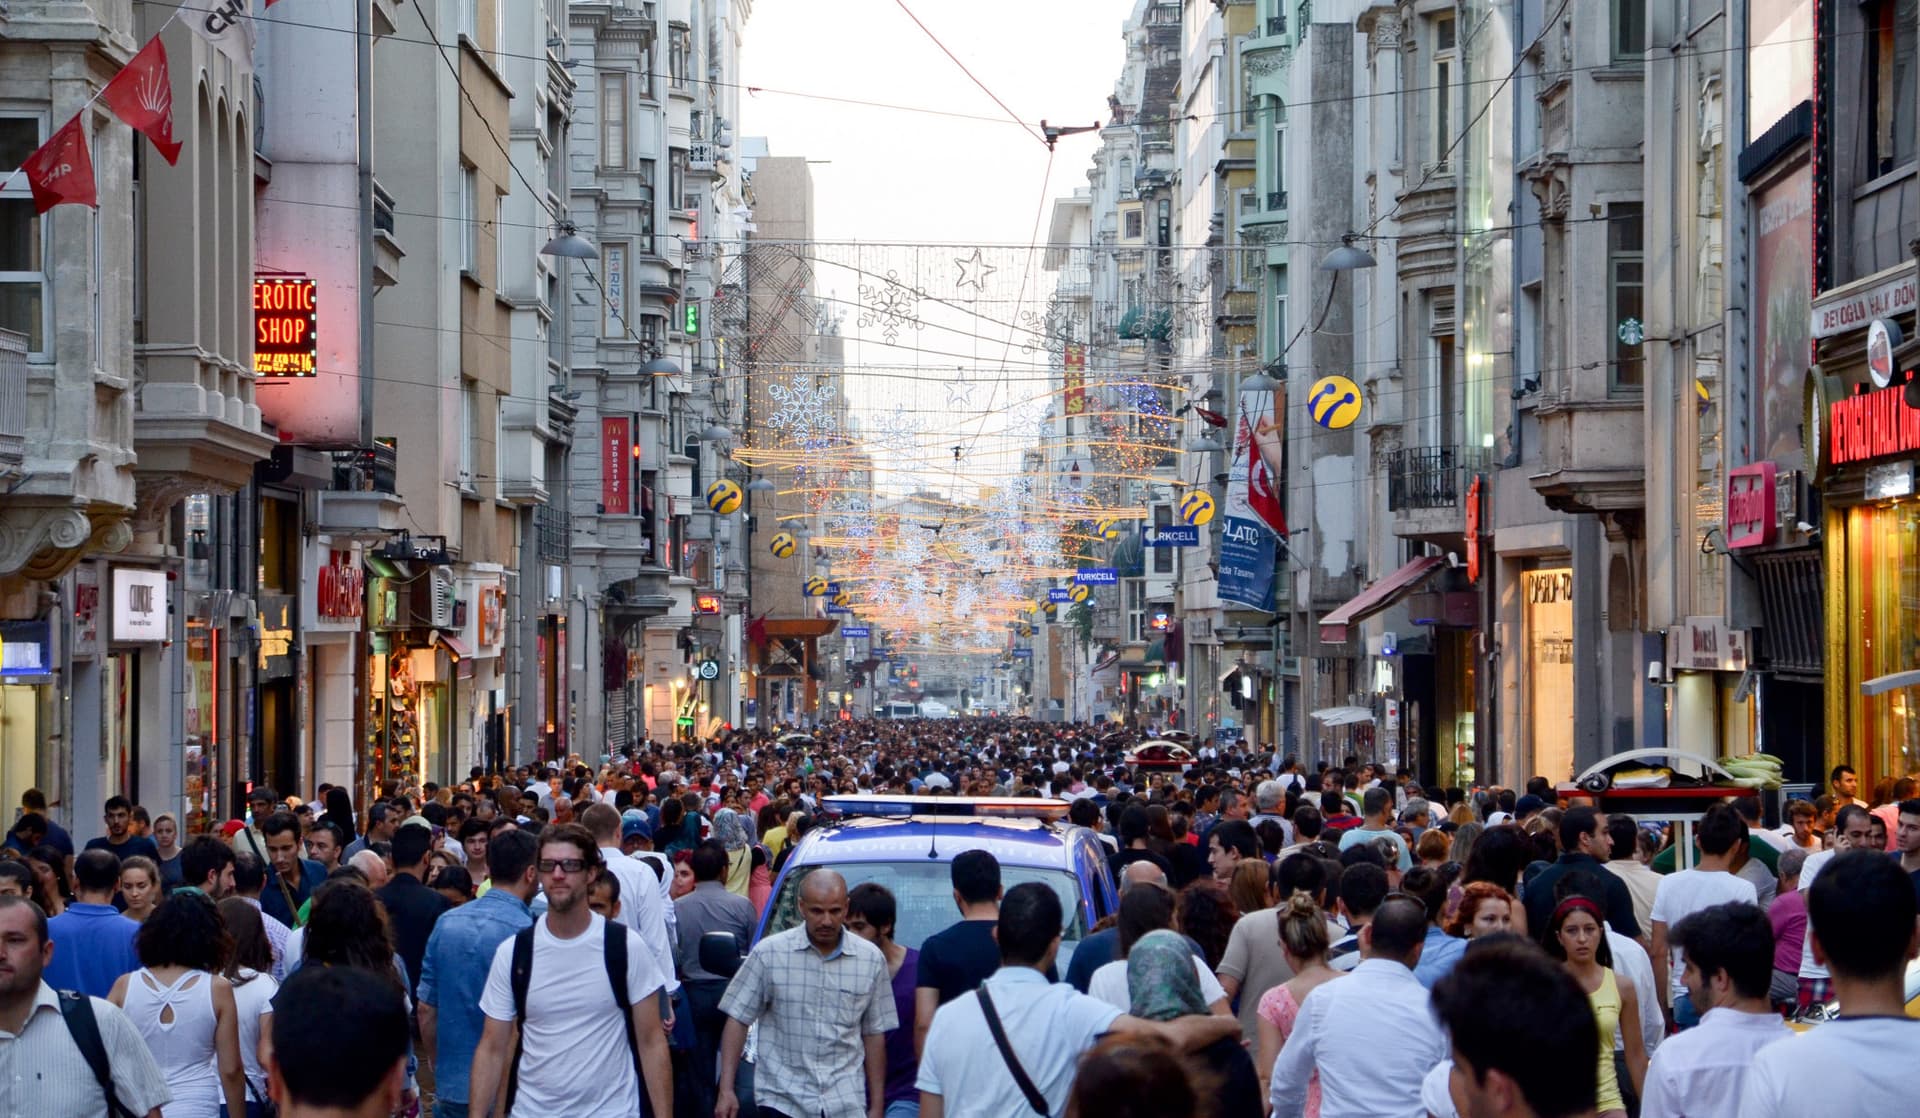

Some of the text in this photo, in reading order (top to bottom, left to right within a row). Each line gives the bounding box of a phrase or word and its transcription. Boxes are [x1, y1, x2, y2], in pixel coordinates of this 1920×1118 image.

[253, 284, 312, 310] EROTIC
[259, 318, 305, 343] SHOP
[1873, 386, 1898, 456] HALK
[1151, 531, 1197, 542] RKCELL
[1076, 572, 1115, 581] TURKCELL
[1050, 590, 1069, 600] TURK
